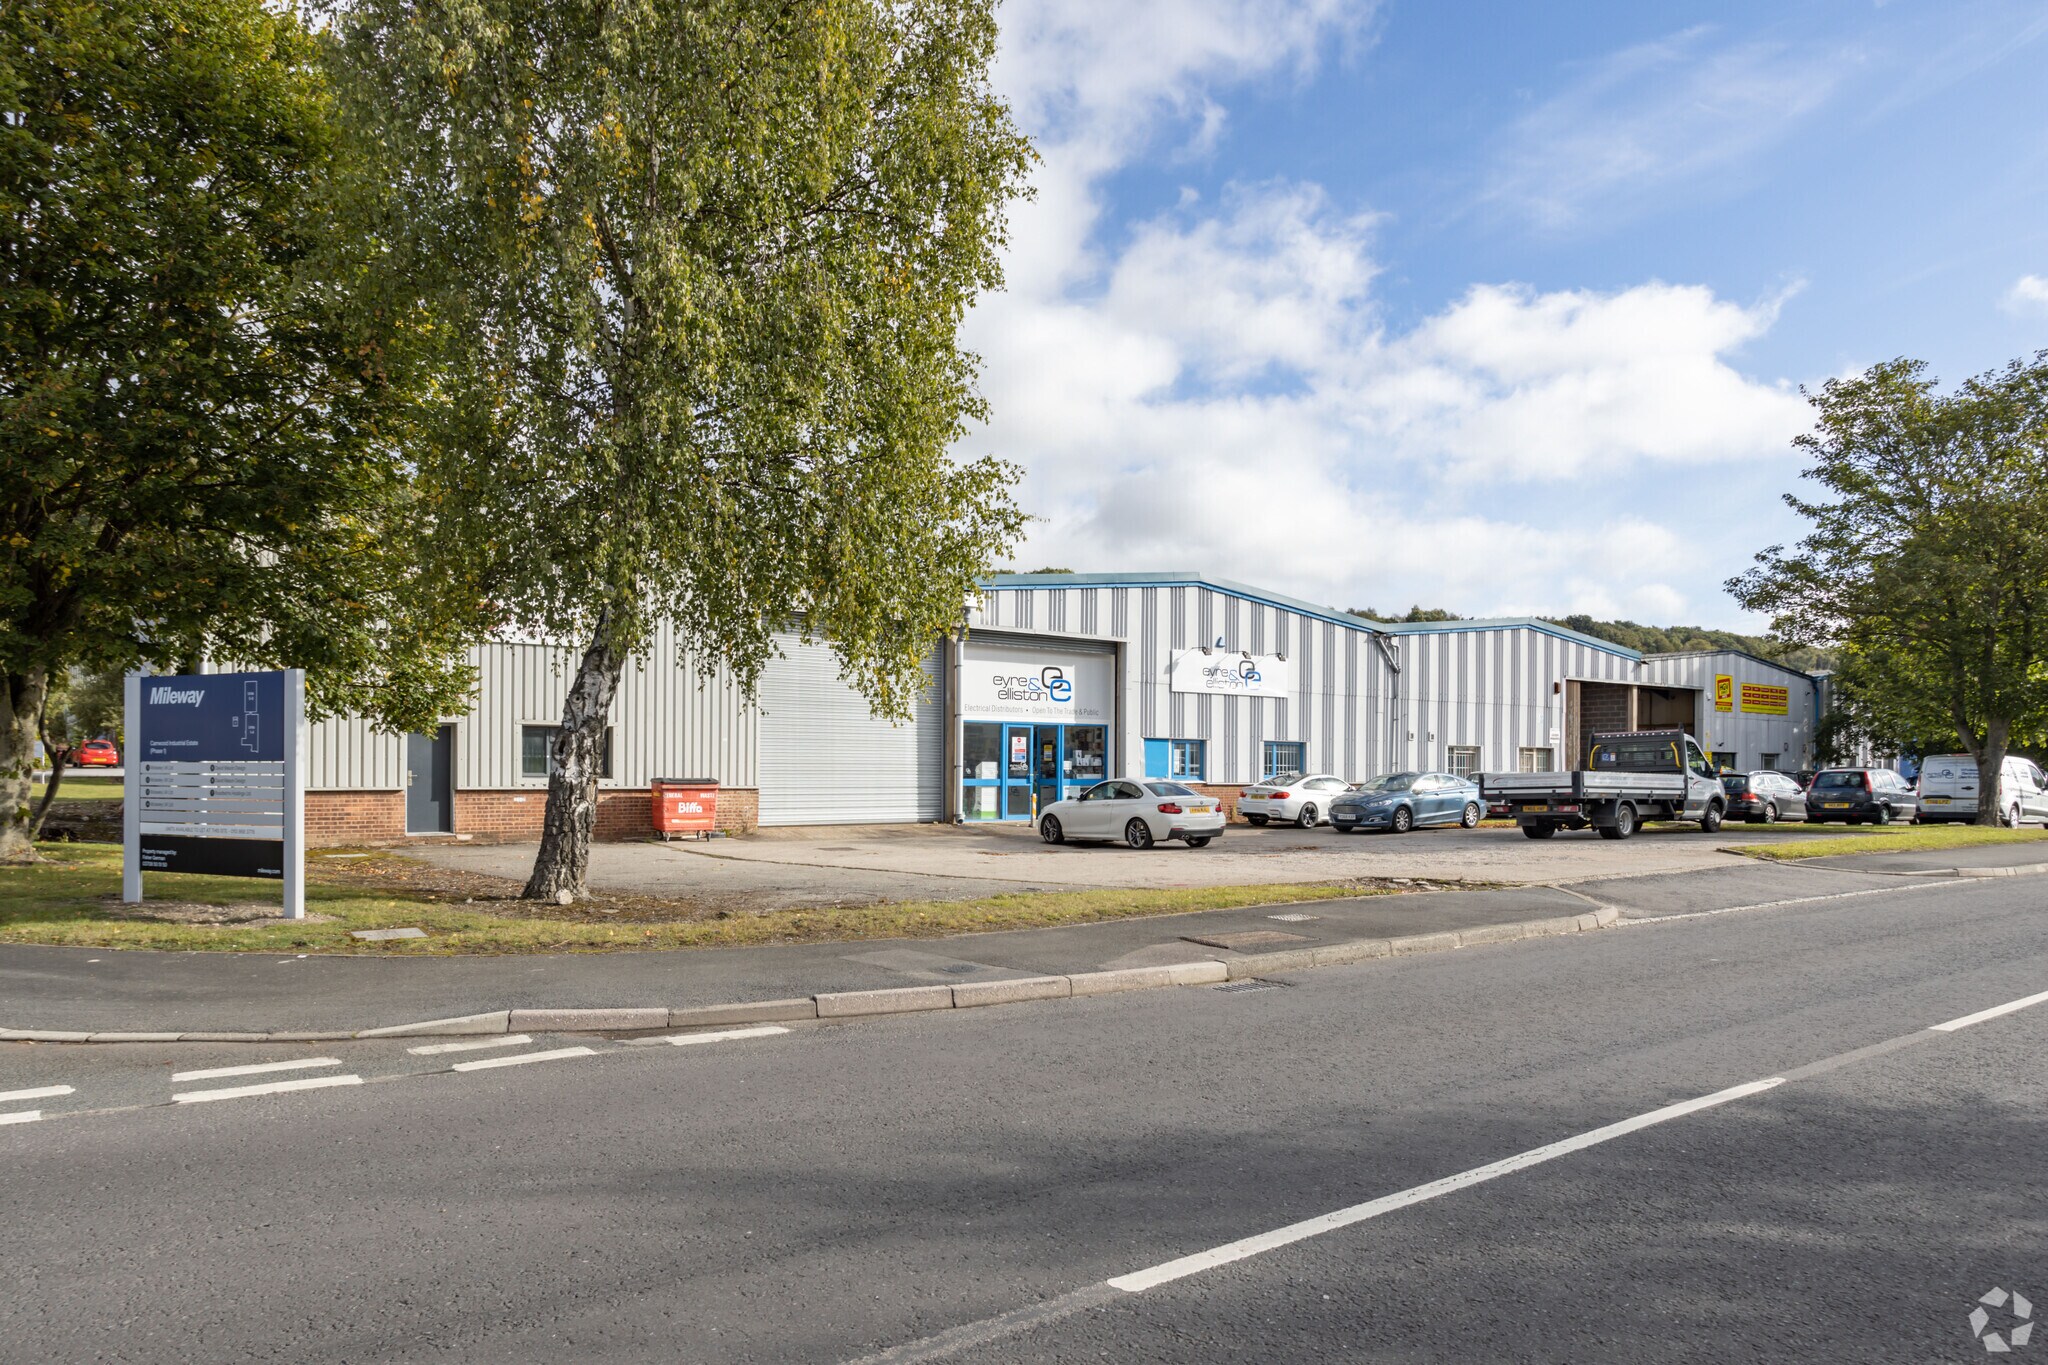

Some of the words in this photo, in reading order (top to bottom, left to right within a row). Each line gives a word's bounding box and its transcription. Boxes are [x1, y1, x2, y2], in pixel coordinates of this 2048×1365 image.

[1203, 668, 1228, 678] eyre
[993, 675, 1027, 688] eyre
[1028, 678, 1042, 691] &
[150, 687, 205, 707] Mileway
[998, 688, 1047, 701] elliston
[964, 704, 990, 712] Electrical
[991, 704, 1023, 713] Distributors
[1032, 706, 1045, 714] Open
[1047, 706, 1053, 714] To
[678, 802, 702, 813] Biffa
[257, 867, 280, 875] mileway.com
